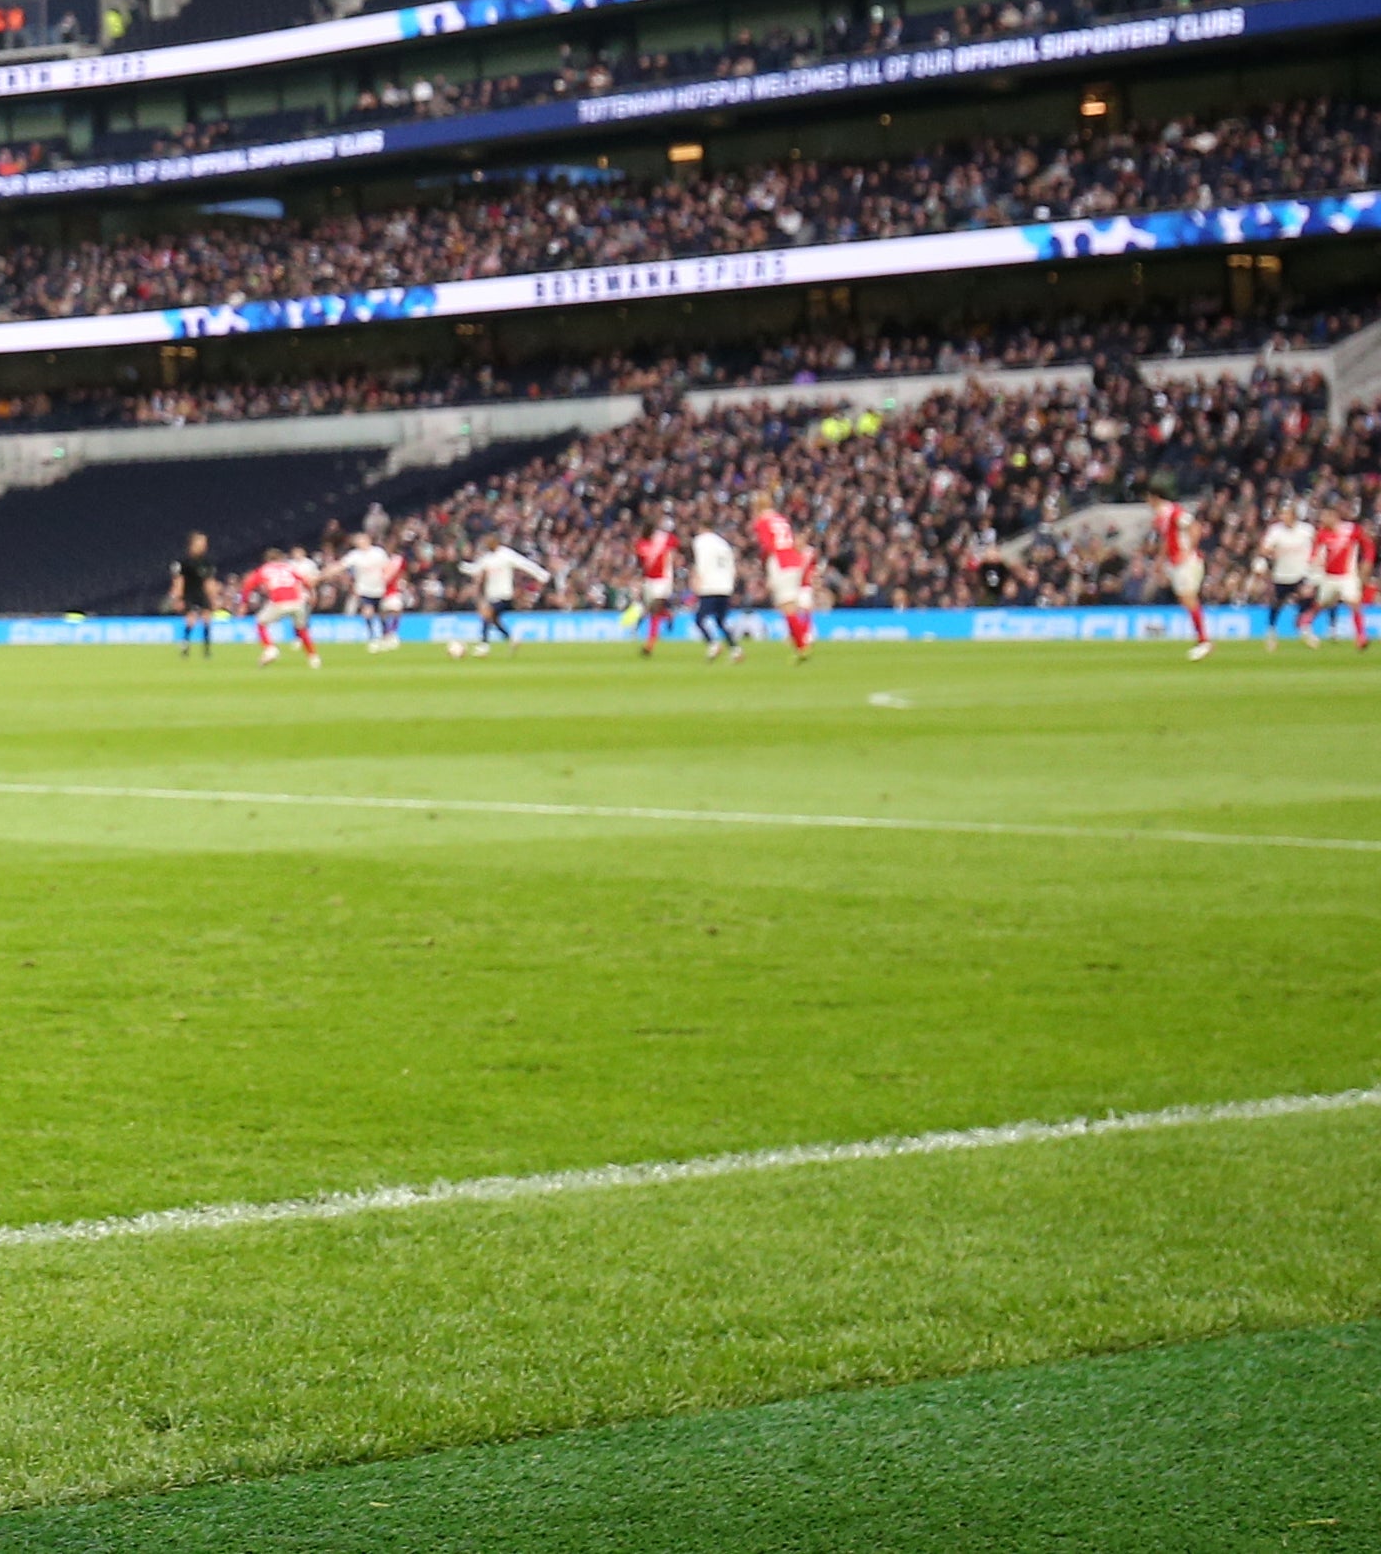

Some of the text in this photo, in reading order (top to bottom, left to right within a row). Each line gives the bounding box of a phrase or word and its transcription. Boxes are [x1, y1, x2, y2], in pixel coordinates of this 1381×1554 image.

[849, 60, 882, 87] ALL
[885, 53, 910, 83] OF
[911, 48, 953, 78] OUR
[954, 37, 1037, 72] OFFICIAL
[1176, 7, 1245, 41] CLUBS
